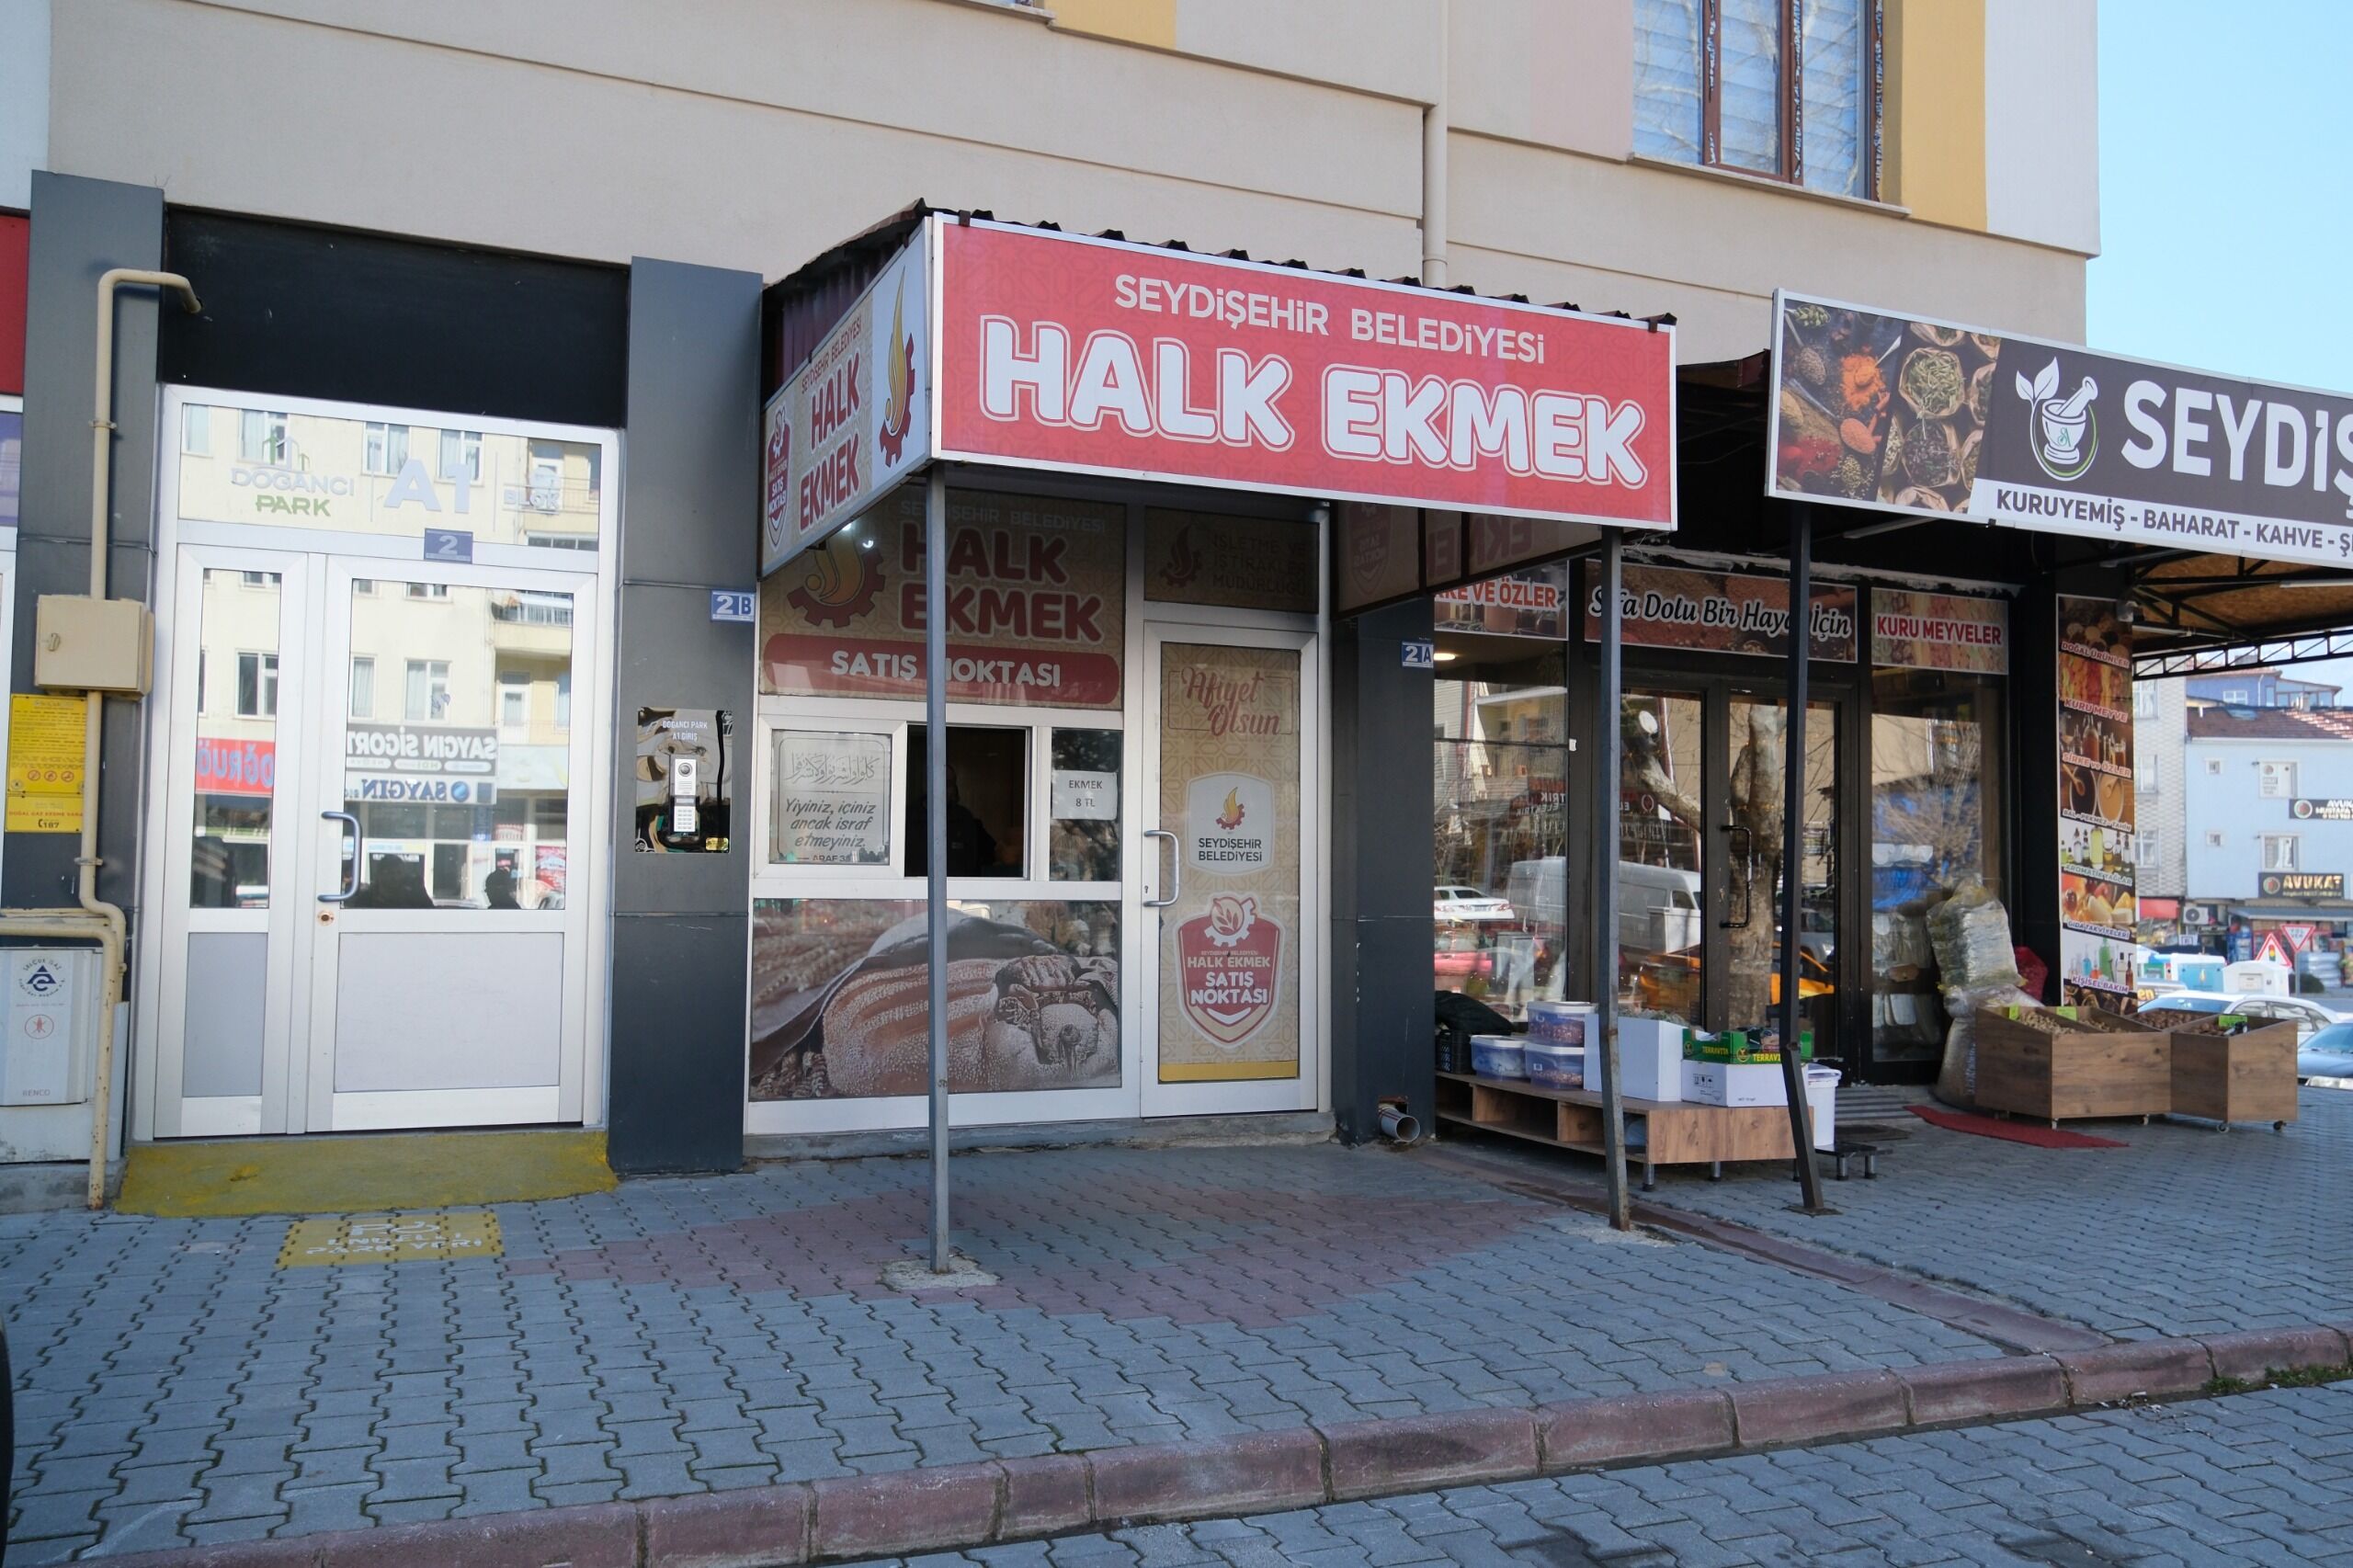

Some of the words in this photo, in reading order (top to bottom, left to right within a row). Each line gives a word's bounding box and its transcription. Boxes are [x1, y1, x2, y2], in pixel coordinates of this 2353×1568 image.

[1114, 274, 1329, 336] SEYDİŞEHİR
[1350, 308, 1544, 364] BELEDİYESİ
[811, 351, 859, 450] HALK
[980, 315, 1294, 451] HALK
[1322, 364, 1648, 489] EKMEK
[383, 459, 471, 514] A1
[801, 432, 859, 530] EKMEK
[256, 494, 331, 517] PARK
[1997, 488, 2124, 532] KURUYEMİŞ
[2143, 509, 2239, 540] BAHARAT
[2256, 524, 2323, 549] KAHVE
[2340, 532, 2353, 557] Ş
[438, 536, 458, 554] 2
[901, 521, 1069, 585] HALK
[1472, 581, 1495, 602] VE
[1499, 577, 1556, 608] ÖZLER
[716, 595, 733, 614] 2
[741, 597, 752, 614] B
[1645, 594, 1696, 620] Dolu
[1704, 599, 1736, 624] Bir
[1744, 600, 1790, 635] Haya
[1812, 604, 1851, 640] İçin
[1877, 616, 1919, 638] KURU
[1923, 620, 2001, 644] MEYVELER
[1405, 645, 1418, 662] 2
[831, 650, 917, 681] SATIŞ
[946, 656, 1062, 687] OKTASI
[1181, 666, 1265, 710] Afiyet
[2064, 699, 2093, 712] KURU
[691, 721, 708, 729] PARK
[1208, 701, 1279, 736] Olsun
[1069, 779, 1103, 789] EKMEK
[786, 798, 834, 816] Yiyiniz,
[837, 801, 877, 817] içiniz
[1075, 798, 1082, 807] 8
[1085, 798, 1096, 807] TL
[2327, 800, 2353, 808] AVUK
[790, 817, 832, 830] ancak
[835, 816, 873, 830] israf
[795, 833, 866, 851] etmeyiniz.
[1199, 837, 1262, 850] SEYDİŞEHİR
[1199, 851, 1262, 862] BELEDİYESİ
[2283, 875, 2343, 890] AVUKAT
[1187, 957, 1223, 968] HALK
[1227, 957, 1270, 968] EKMEK
[1205, 971, 1255, 988] SATIŞ
[1190, 988, 1267, 1005] NOKTASI
[1753, 1053, 1780, 1062] TERRAVI
